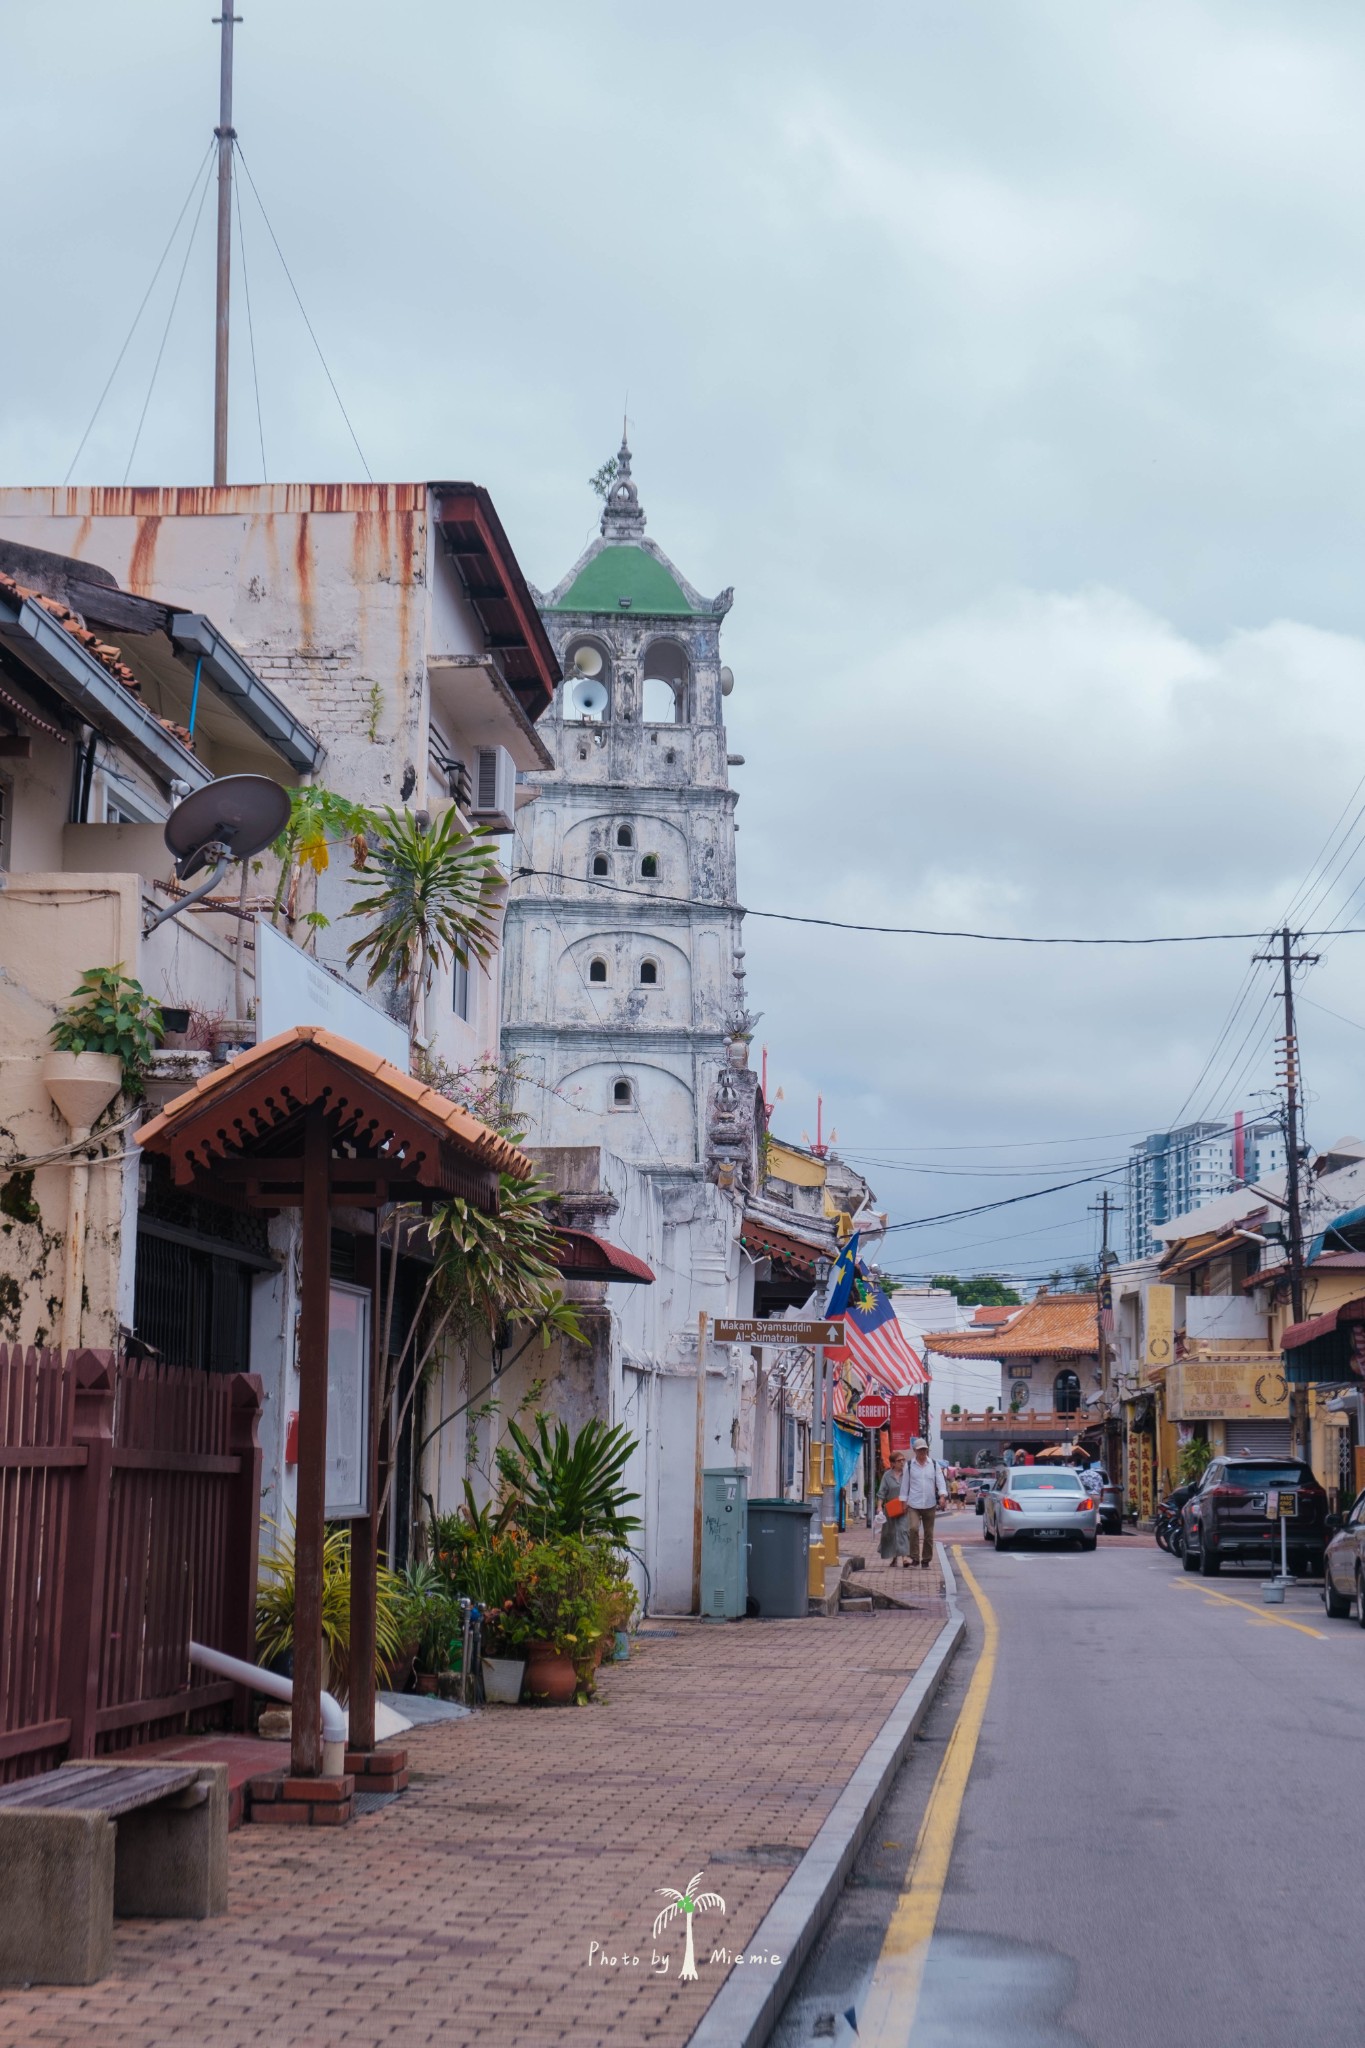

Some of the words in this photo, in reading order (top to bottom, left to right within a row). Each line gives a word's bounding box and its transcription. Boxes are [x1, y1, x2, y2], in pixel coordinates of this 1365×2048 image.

[720, 1321, 752, 1330] Makam
[756, 1322, 812, 1333] Syamsuddin
[735, 1331, 798, 1343] Al-Sumatrani
[857, 1405, 888, 1418] BERHENTI
